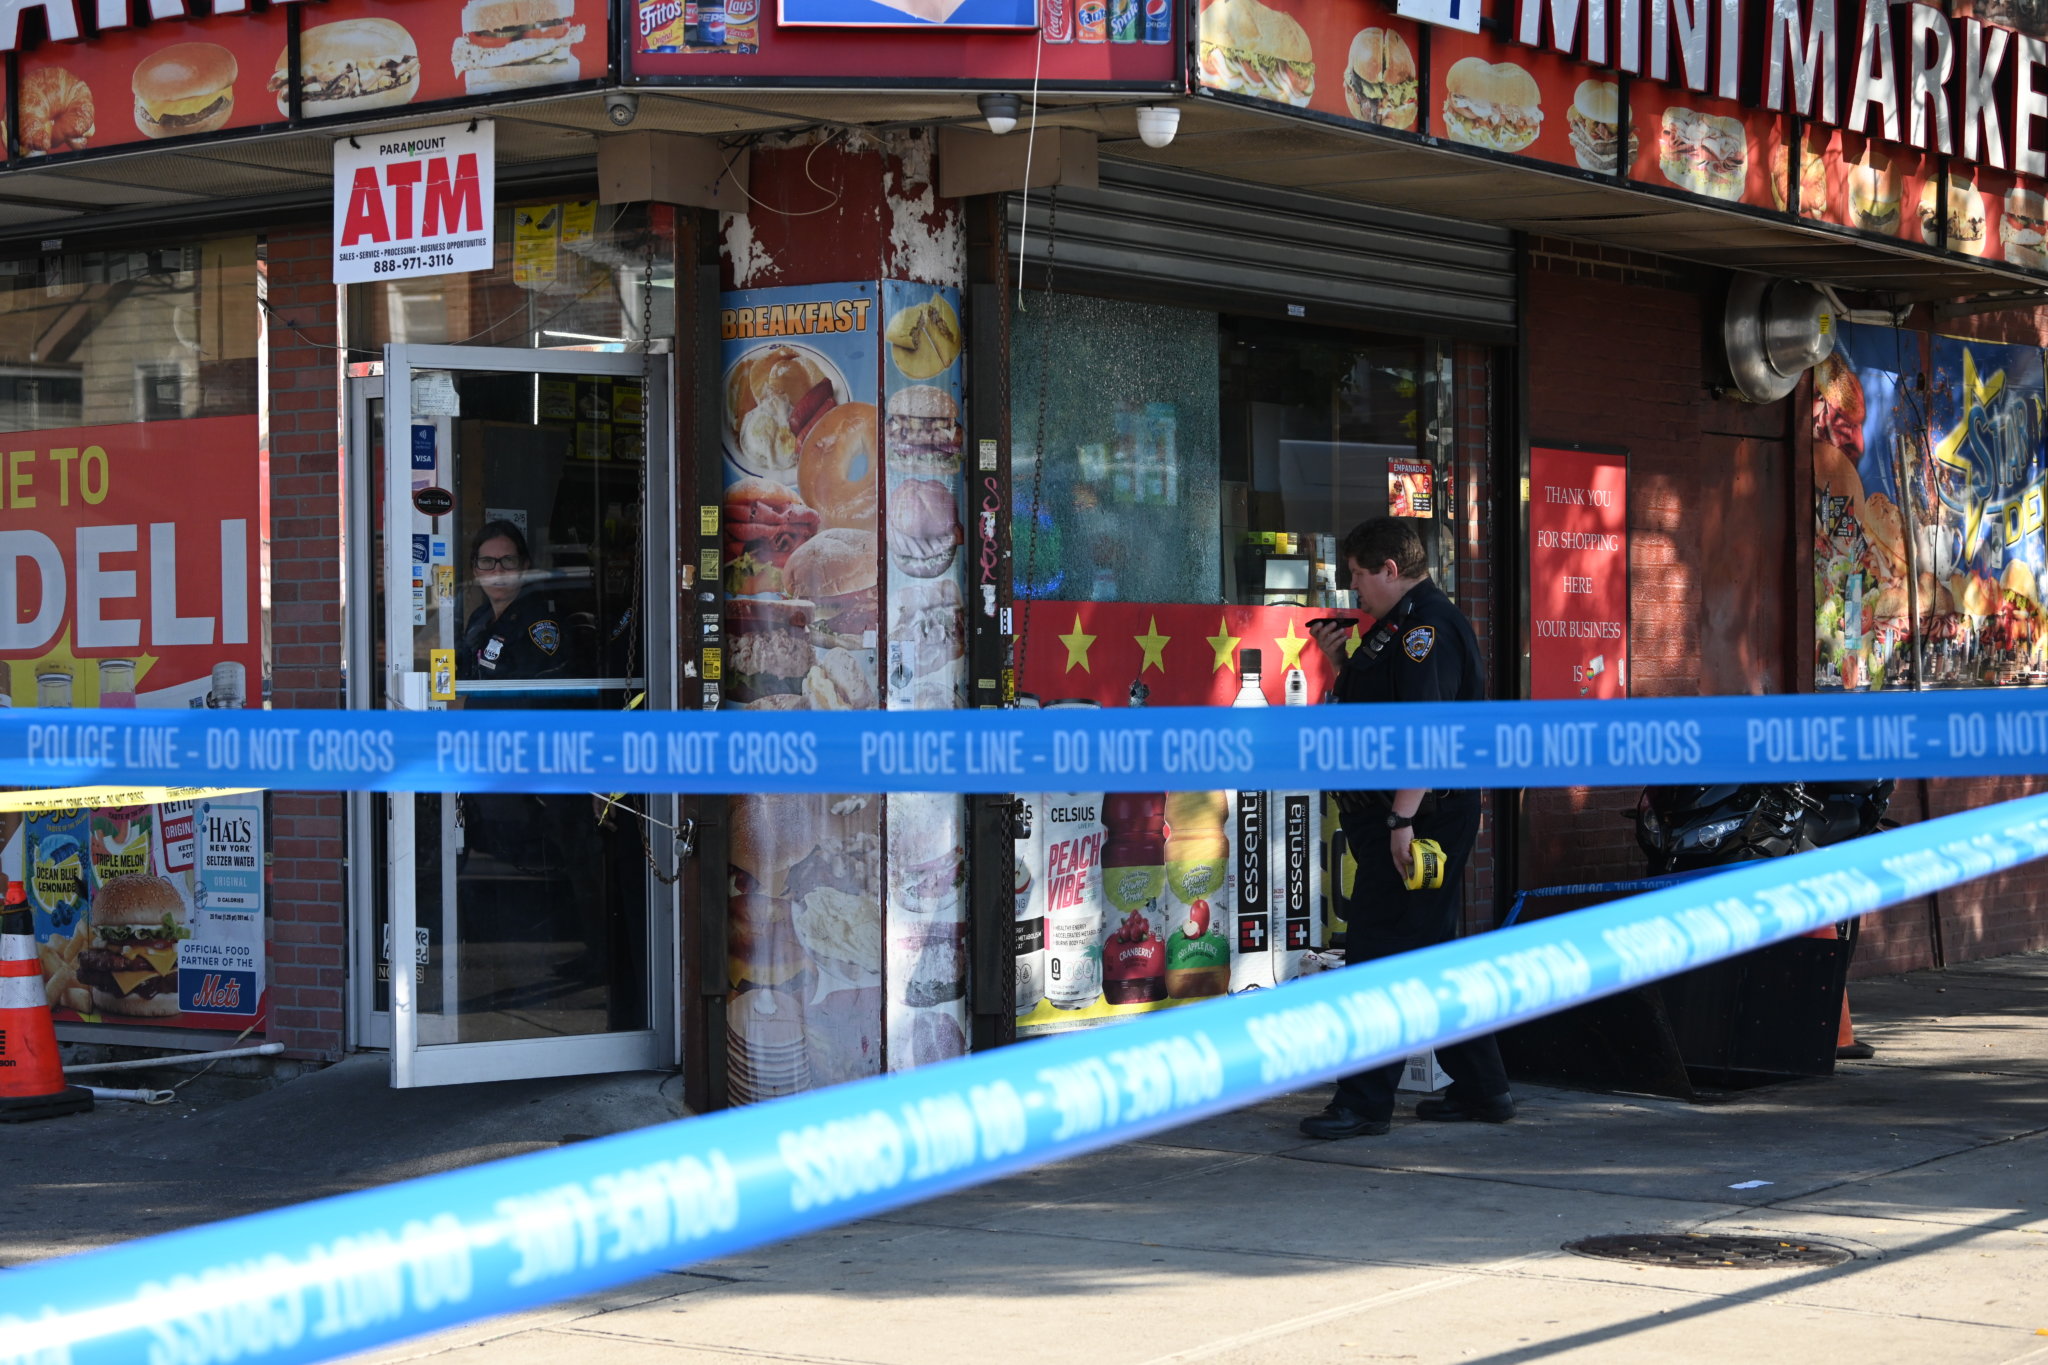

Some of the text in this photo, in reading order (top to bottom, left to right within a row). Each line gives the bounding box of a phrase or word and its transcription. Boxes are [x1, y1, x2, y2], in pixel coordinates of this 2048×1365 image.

[640, 0, 682, 36] Fritos
[1110, 3, 1138, 37] Sprite
[380, 137, 446, 156] PARAMOUNT
[341, 152, 483, 246] ATM
[339, 237, 487, 261] SALES SERVICE PROCESSING BUSINESS OPPORTUNITIES
[373, 254, 454, 273] 888-971-3116
[720, 299, 871, 340] BREAKFAST
[415, 454, 432, 462] VISA
[1393, 463, 1427, 473] EMPANADAS
[50, 445, 109, 506] TO
[1544, 485, 1612, 508] THANK YOU
[1537, 530, 1619, 552] FOR SHOPPING
[0, 518, 248, 650] DELI
[1562, 576, 1593, 595] HERE
[1536, 620, 1621, 639] YOUR BUSINESS
[1572, 665, 1583, 682] IS
[27, 724, 117, 768] POLICE
[124, 726, 180, 769] LINE
[206, 728, 241, 770] DO
[249, 728, 300, 771] NOT
[308, 729, 394, 772] CROSS
[1300, 726, 1396, 771] POLICE
[1406, 725, 1467, 770] LINE
[1496, 723, 1533, 768] DO
[1543, 721, 1598, 768] NOT
[1607, 720, 1702, 767] CROSS
[1747, 716, 1847, 764] POLICE
[1856, 715, 1919, 760] LINE
[1949, 712, 1987, 758] DO
[1996, 711, 2048, 757] NOT
[436, 730, 529, 774] POLICE
[537, 731, 595, 774] LINE
[622, 732, 658, 774] DO
[667, 732, 719, 775] NOT
[728, 731, 817, 775] CROSS
[861, 730, 956, 775] POLICE
[965, 730, 1025, 774] LINE
[1053, 730, 1089, 774] DO
[1099, 729, 1153, 774] NOT
[1161, 728, 1254, 774] CROSS
[1051, 806, 1095, 823] CELSIUS
[209, 816, 251, 843] HAL'S
[96, 853, 145, 868] TRIPLE MELON
[206, 855, 255, 868] SELTZER WATER
[1047, 832, 1102, 878] PEACH
[1289, 803, 1303, 910] essentia
[36, 867, 78, 881] OCEAN BLUE
[214, 876, 247, 888] ORIGINAL
[39, 881, 77, 893] LEMONADE
[1047, 871, 1088, 912] VIBE
[184, 944, 250, 956] OFFICIAL FOOD
[1119, 946, 1153, 961] CRANBERRY
[1187, 941, 1204, 952] APPLE
[1204, 942, 1218, 957] JUICE
[181, 955, 253, 968] PARTNER OF THE
[192, 973, 241, 1008] Mets
